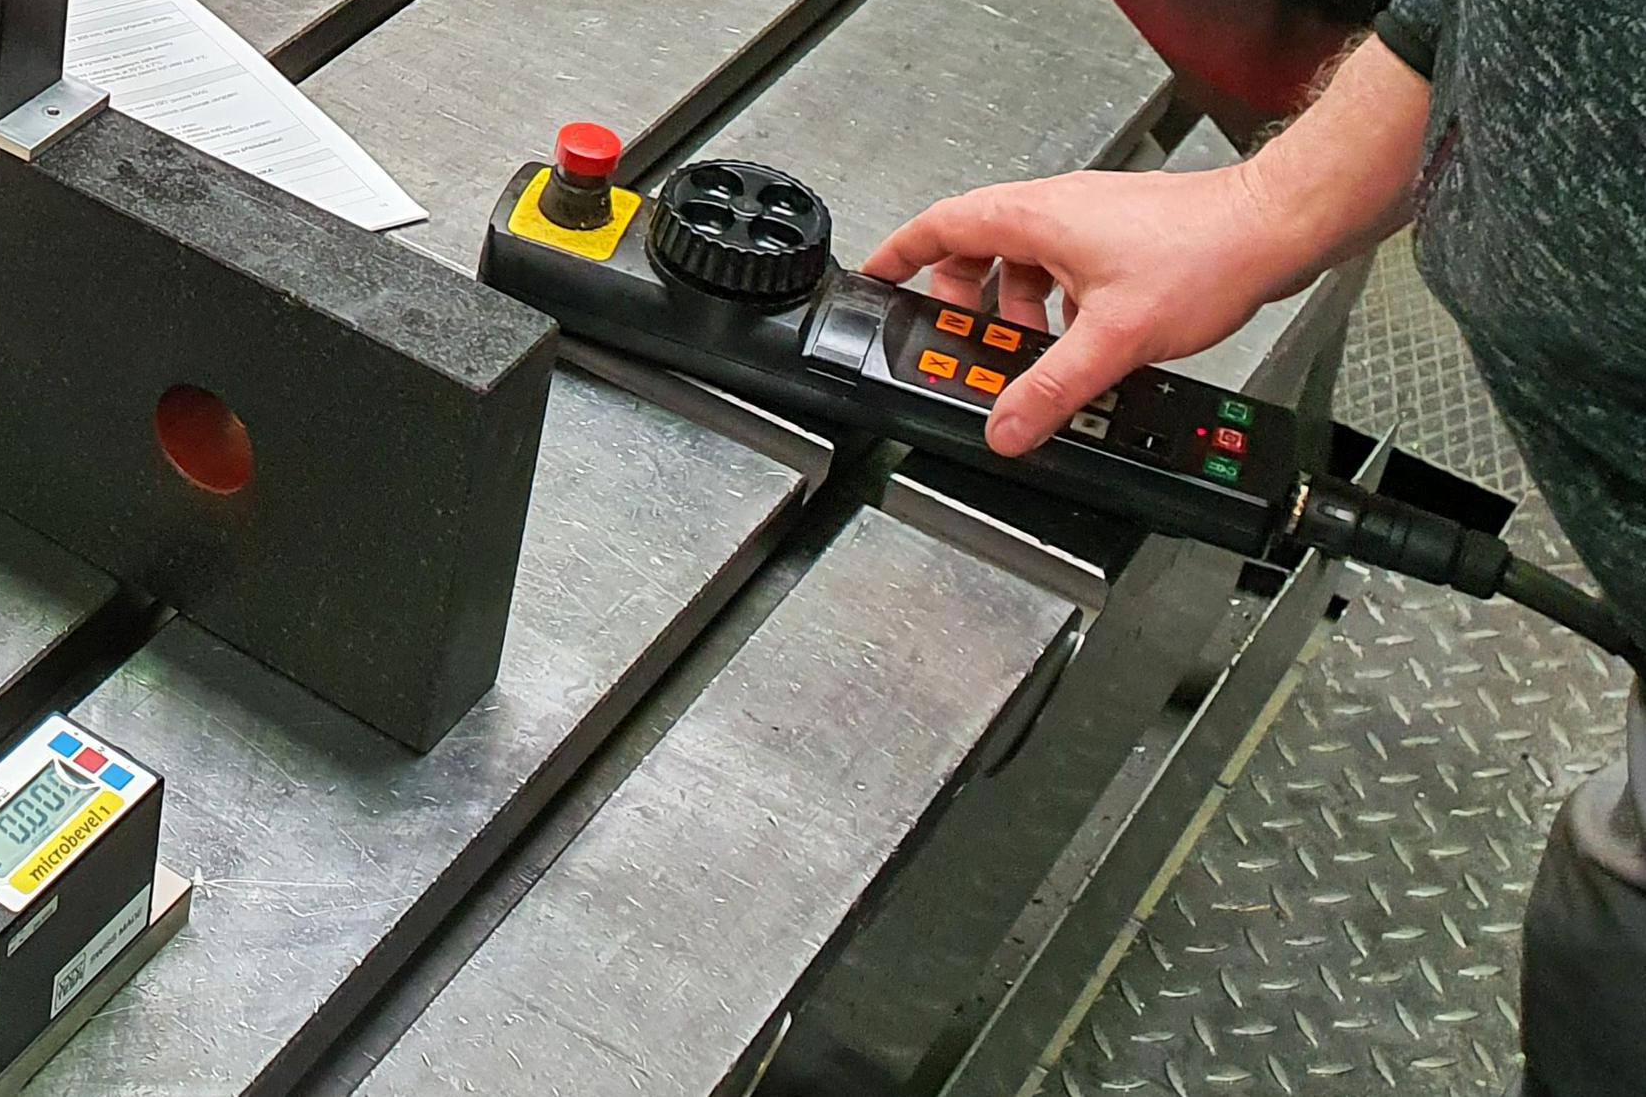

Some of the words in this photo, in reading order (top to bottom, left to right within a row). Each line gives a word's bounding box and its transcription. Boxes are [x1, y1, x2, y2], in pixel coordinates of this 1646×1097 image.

[928, 357, 950, 371] X
[975, 372, 995, 383] Y
[29, 810, 103, 882] microbevel
[100, 805, 112, 816] 1
